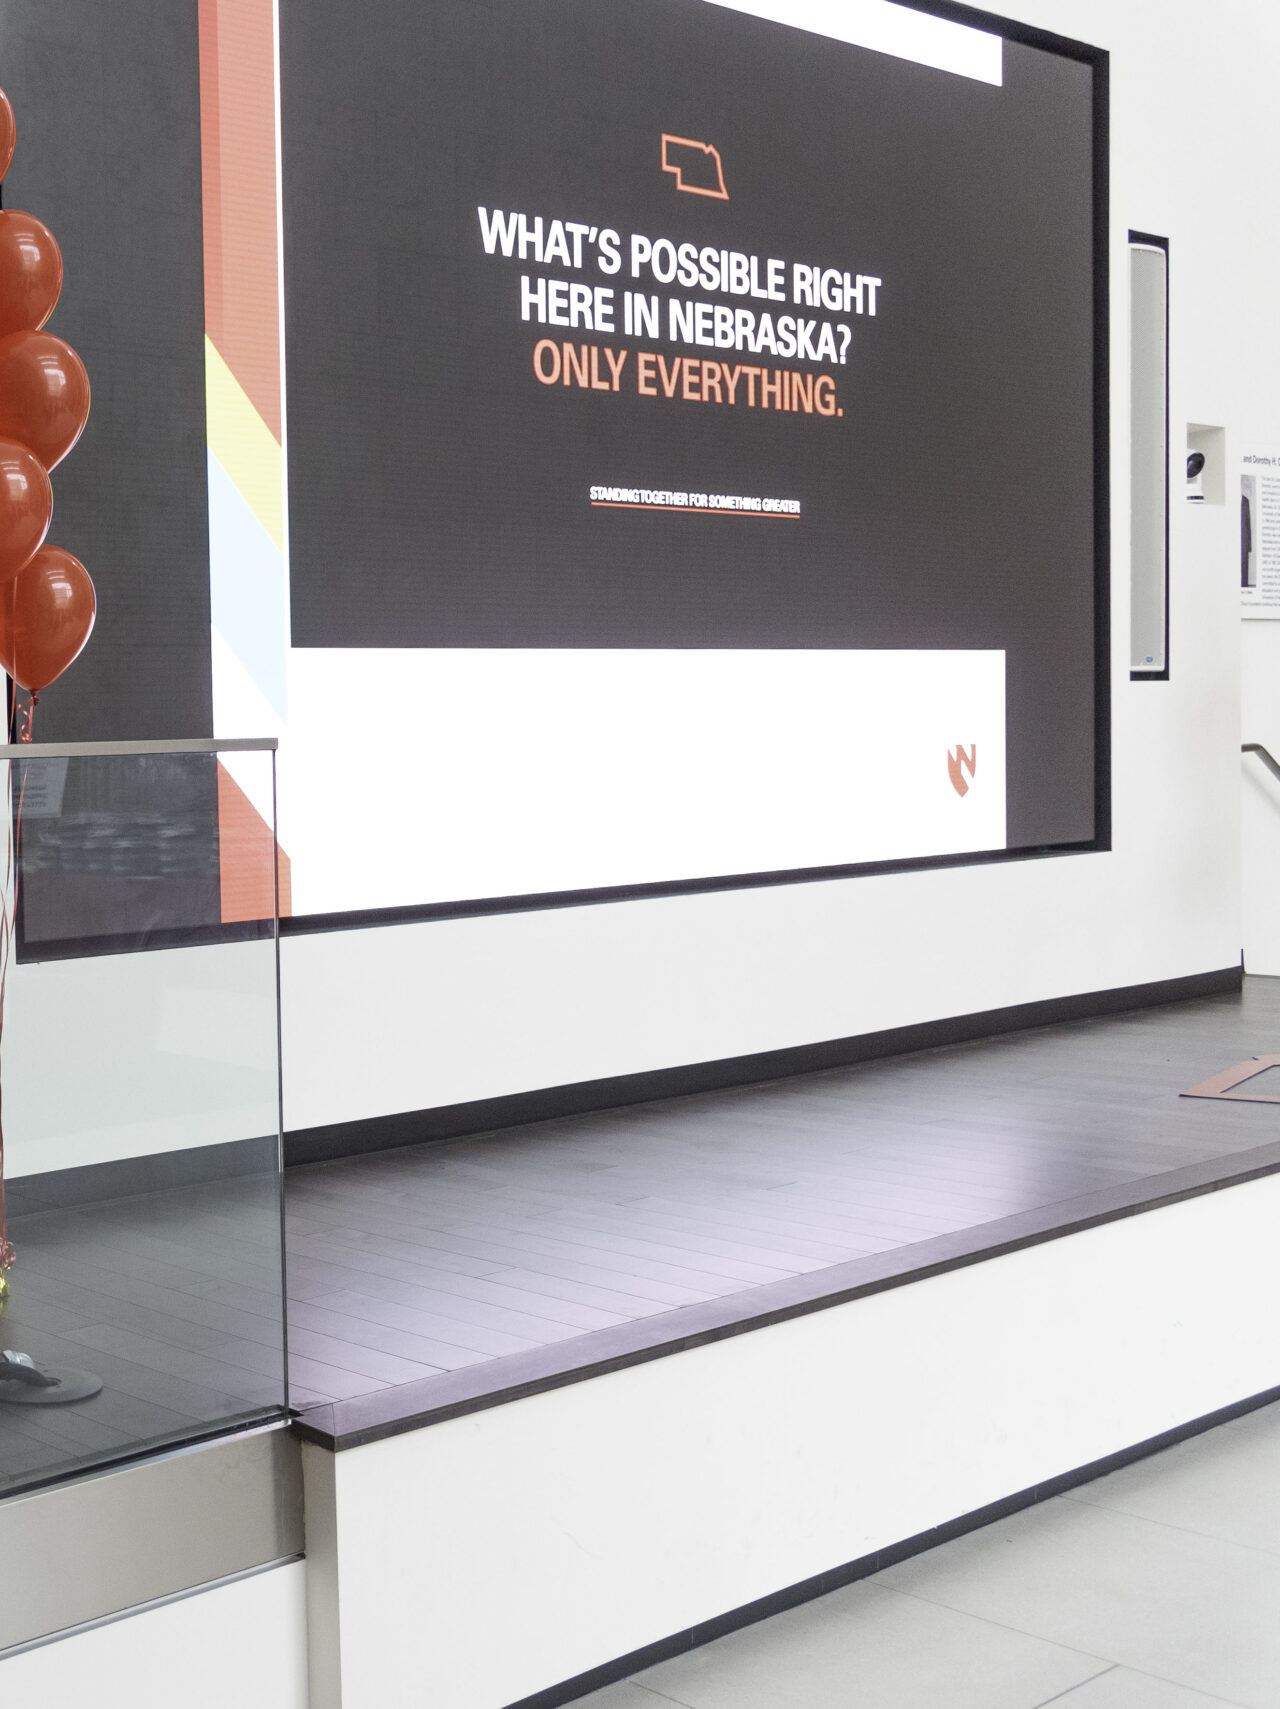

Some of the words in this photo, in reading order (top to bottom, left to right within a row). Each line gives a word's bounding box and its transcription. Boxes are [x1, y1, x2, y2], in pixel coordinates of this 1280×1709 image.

[477, 206, 622, 275] WHAT'S
[631, 234, 785, 301] POSSIBLE
[793, 263, 882, 316] RIGHT
[520, 275, 615, 333] HERE
[624, 291, 659, 339] IN
[668, 299, 852, 365] NEBRASKA?
[533, 339, 627, 392] ONLY
[637, 352, 844, 417] EVERYTHING.
[589, 486, 639, 503] STANDING
[639, 489, 688, 506] TOGETHER
[689, 493, 708, 508] FOR
[708, 495, 762, 511] SOMETHING
[762, 498, 801, 514] GREATER
